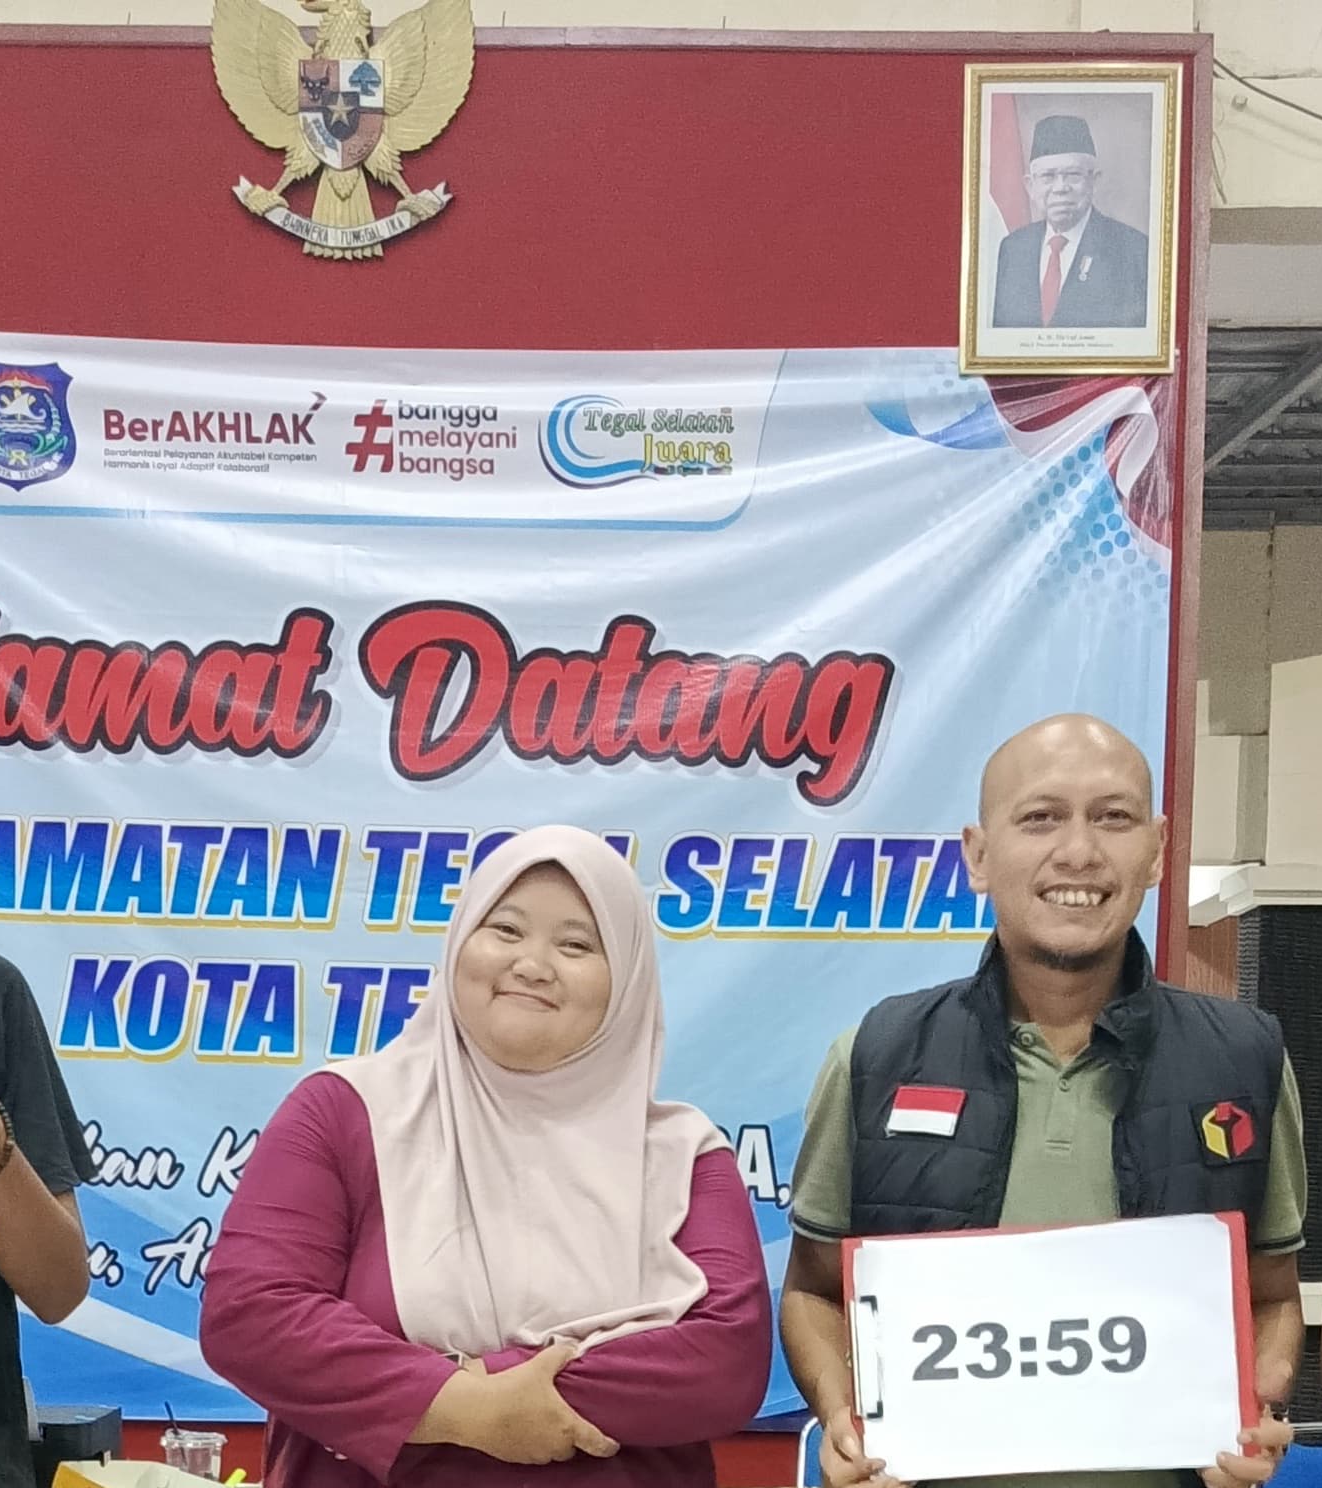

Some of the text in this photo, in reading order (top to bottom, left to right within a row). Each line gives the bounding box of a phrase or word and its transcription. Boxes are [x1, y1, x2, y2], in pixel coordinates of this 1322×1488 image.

[103, 409, 316, 445] BerAKHLAK
[398, 400, 498, 428] bangga
[583, 407, 735, 437] Tegal Selatan
[398, 426, 517, 454] melayani
[641, 433, 733, 473] Juara
[399, 452, 494, 481] bangsa
[357, 599, 896, 806] Datang
[59, 954, 304, 1060] KOTA
[911, 1316, 1147, 1381] 23:59
